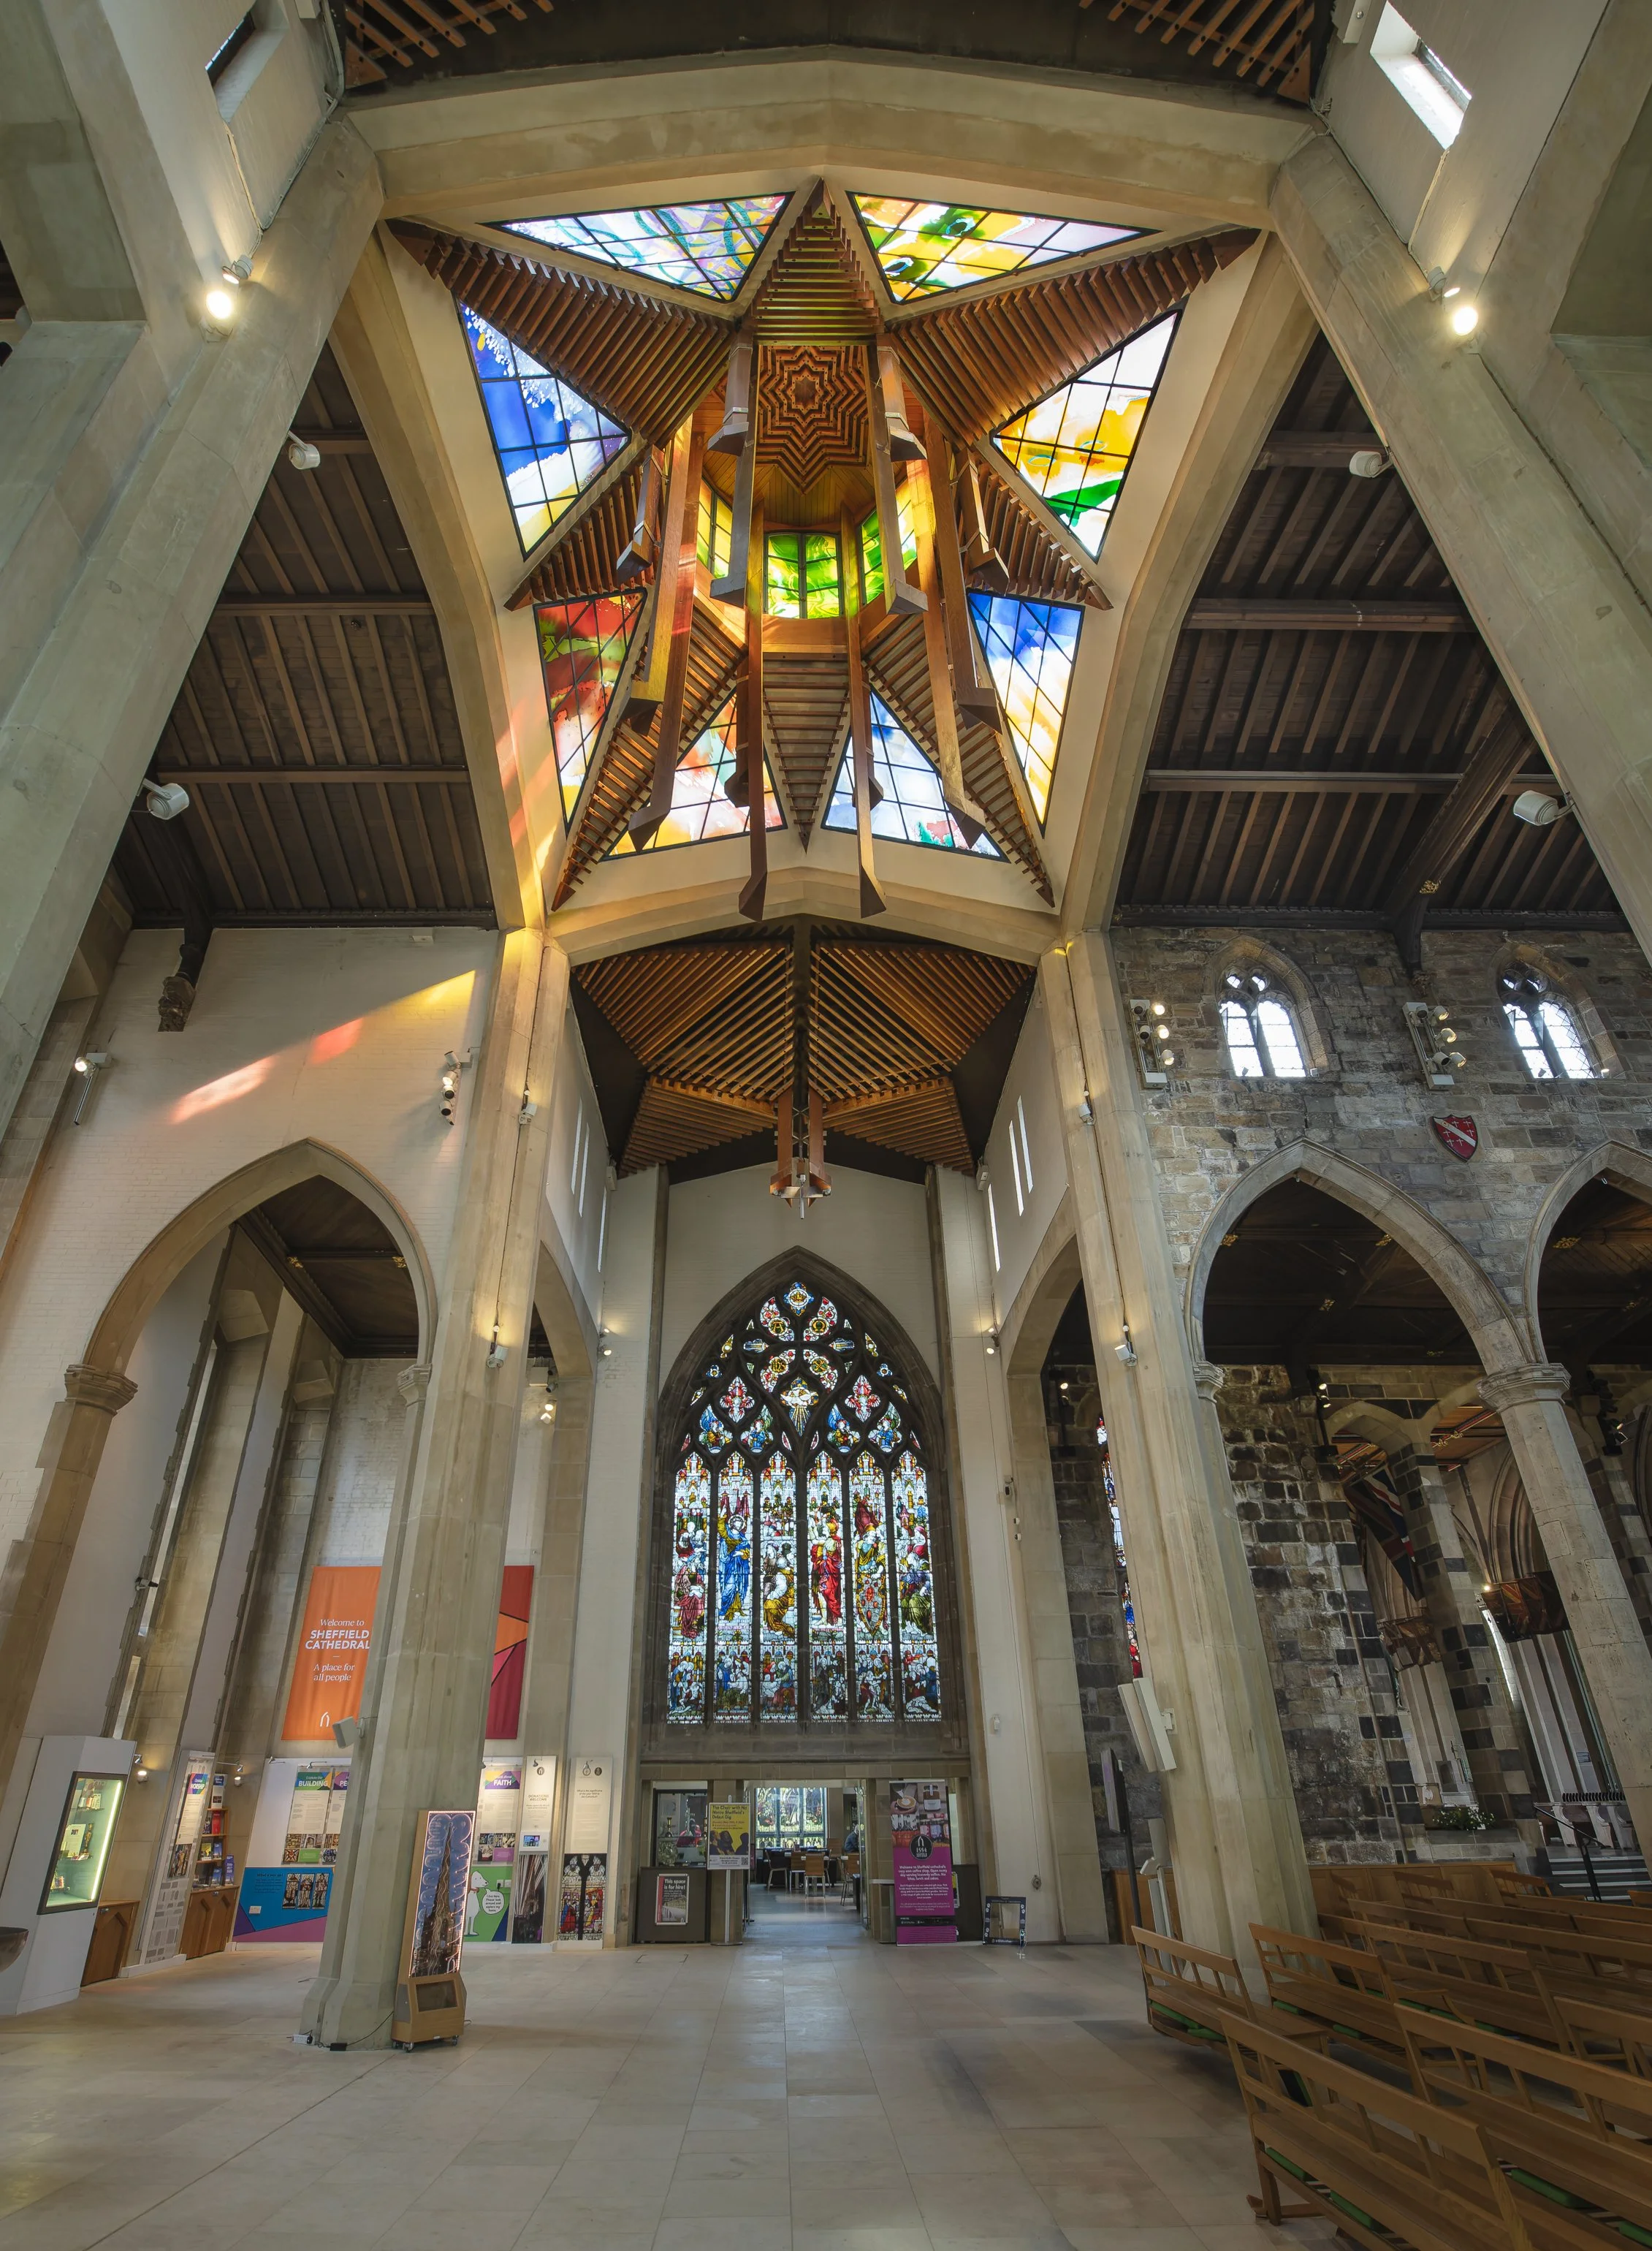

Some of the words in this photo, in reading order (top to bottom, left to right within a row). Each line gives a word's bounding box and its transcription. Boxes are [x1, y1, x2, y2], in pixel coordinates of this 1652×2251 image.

[310, 1630, 370, 1639] SHEFFIELD
[305, 1640, 370, 1650] CATHEDRAL
[321, 1663, 342, 1672] place
[343, 1663, 355, 1671] for
[313, 1673, 324, 1681] all
[325, 1673, 351, 1682] people
